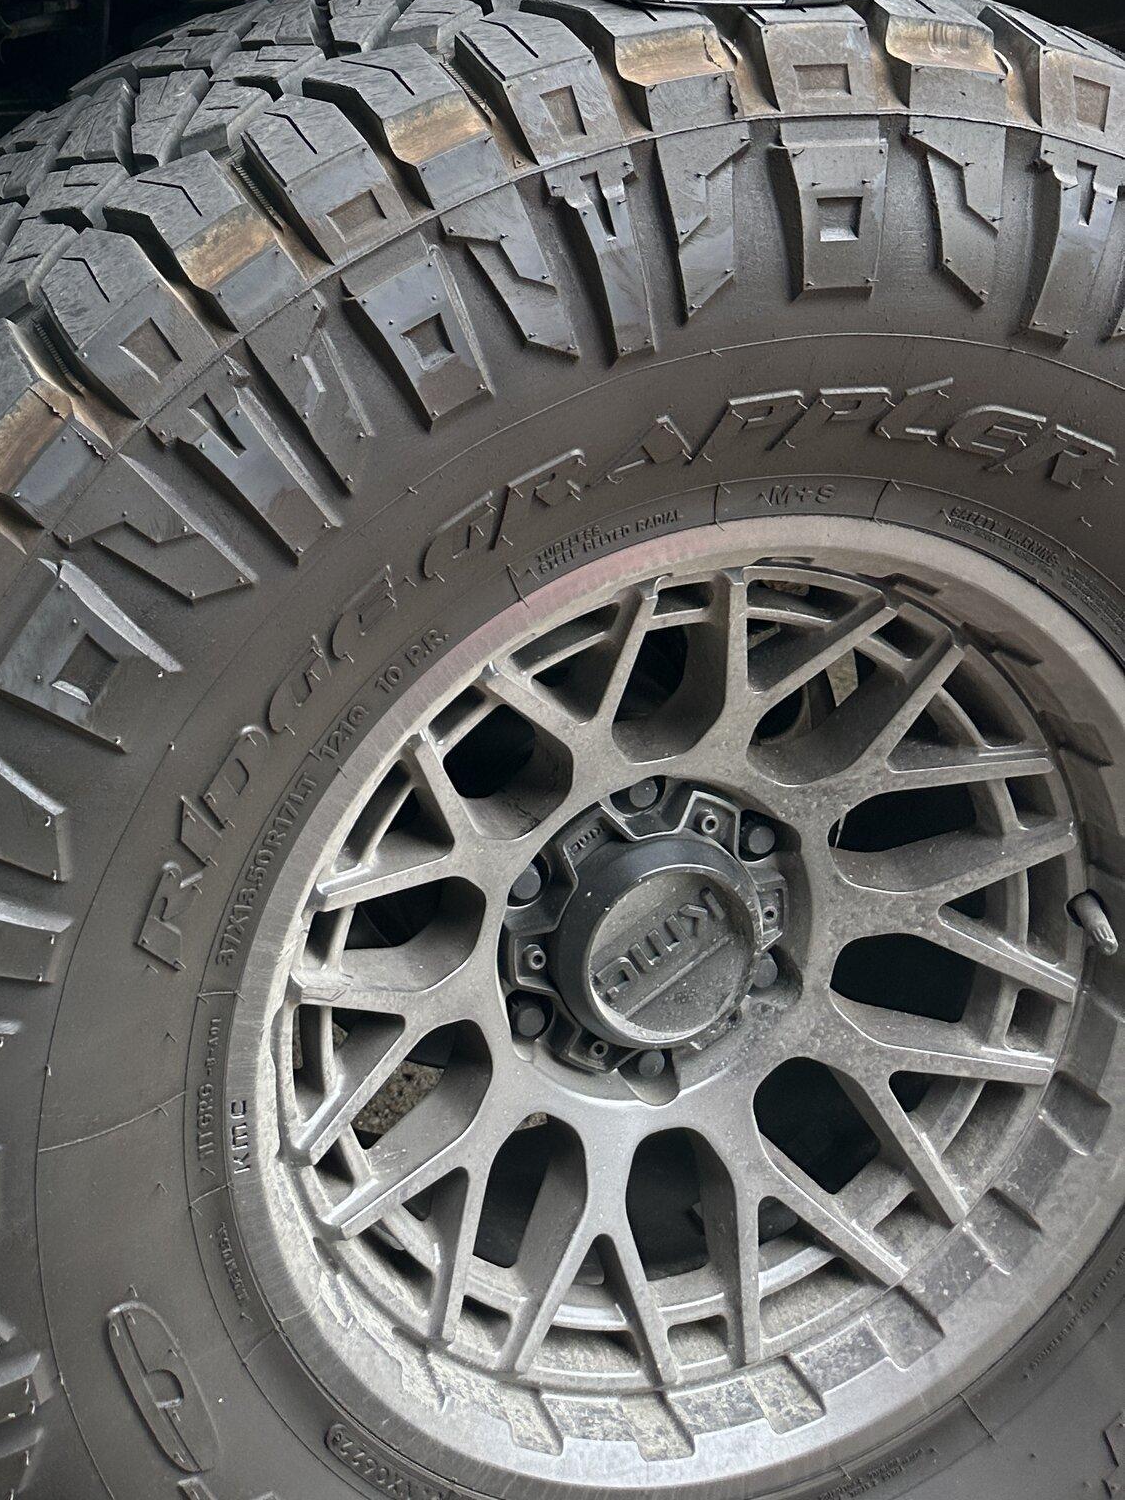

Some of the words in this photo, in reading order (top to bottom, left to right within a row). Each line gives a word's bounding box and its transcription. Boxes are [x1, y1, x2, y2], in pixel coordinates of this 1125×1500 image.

[769, 484, 837, 506] M+S
[536, 524, 602, 562] TUBELESS
[538, 547, 576, 574] STEEL
[582, 524, 631, 552] BELTED
[635, 509, 683, 532] RADIAL
[134, 564, 399, 972] RIDGE
[421, 376, 1118, 580] GRAPPLER
[376, 665, 406, 694] 10
